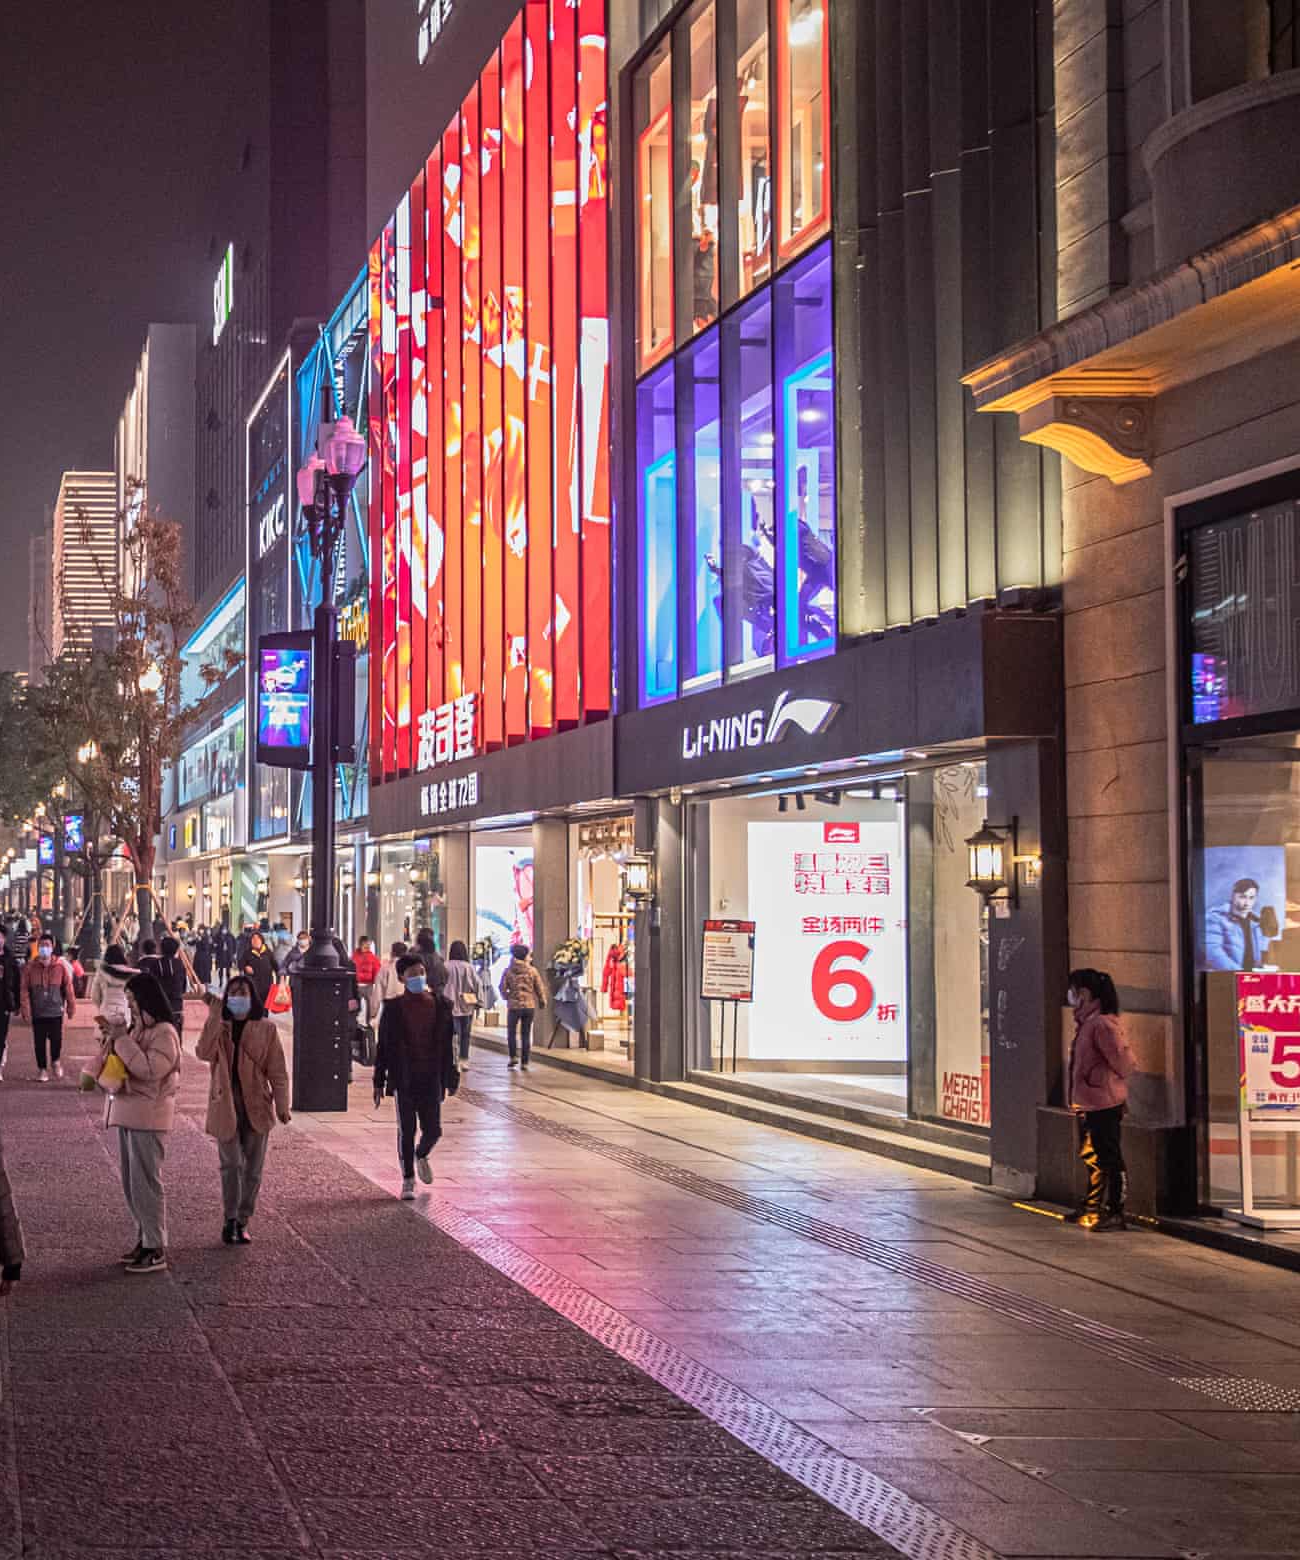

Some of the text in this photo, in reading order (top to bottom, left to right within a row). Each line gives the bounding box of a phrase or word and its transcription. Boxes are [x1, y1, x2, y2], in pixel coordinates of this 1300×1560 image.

[417, 693, 477, 771] 波司登
[682, 709, 766, 759] LI-NING
[811, 940, 875, 1022] 6
[877, 1003, 898, 1022] 折
